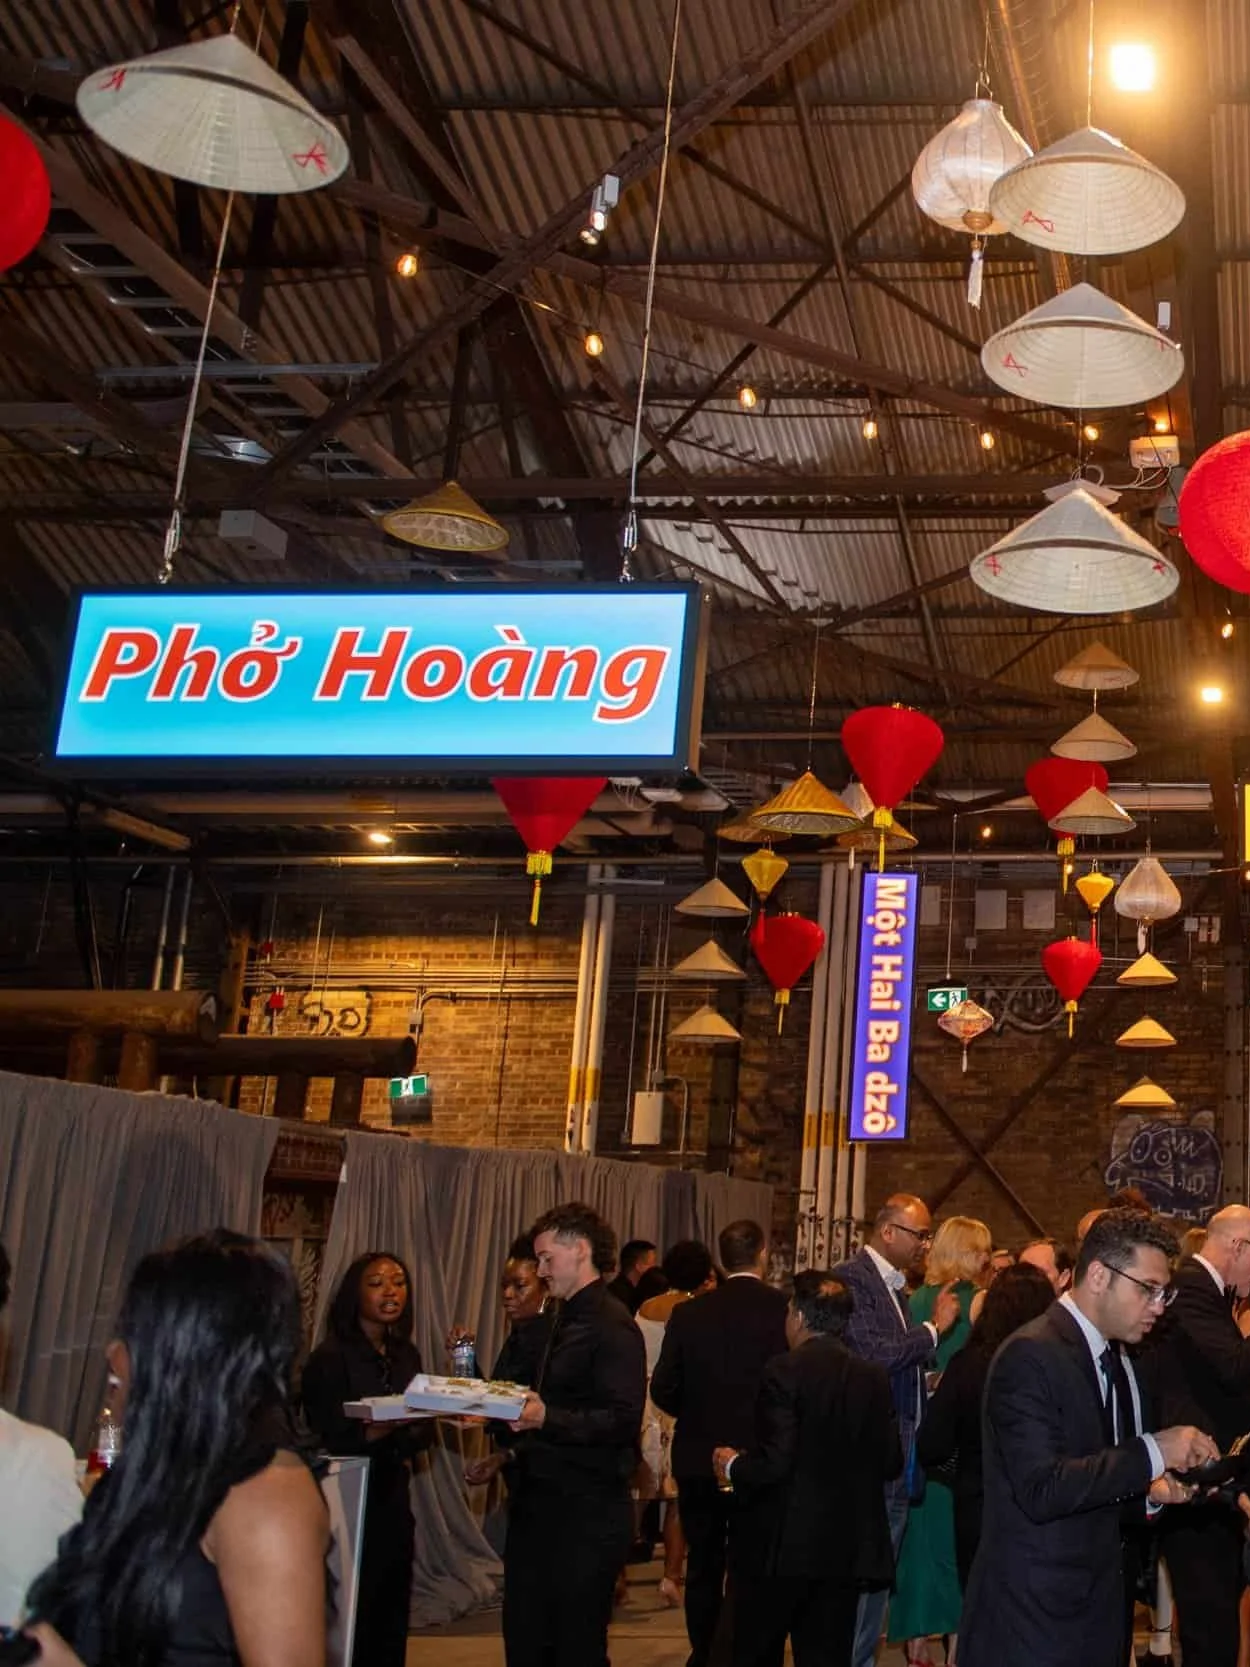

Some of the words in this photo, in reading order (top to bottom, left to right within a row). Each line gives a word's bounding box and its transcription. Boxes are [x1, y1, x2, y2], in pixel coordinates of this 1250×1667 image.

[79, 619, 301, 702] Phở
[312, 624, 672, 724] Hoàng
[866, 877, 908, 947] Một
[869, 955, 904, 1011] Hai
[866, 1019, 900, 1063] Ba
[862, 1071, 899, 1135] dzô
